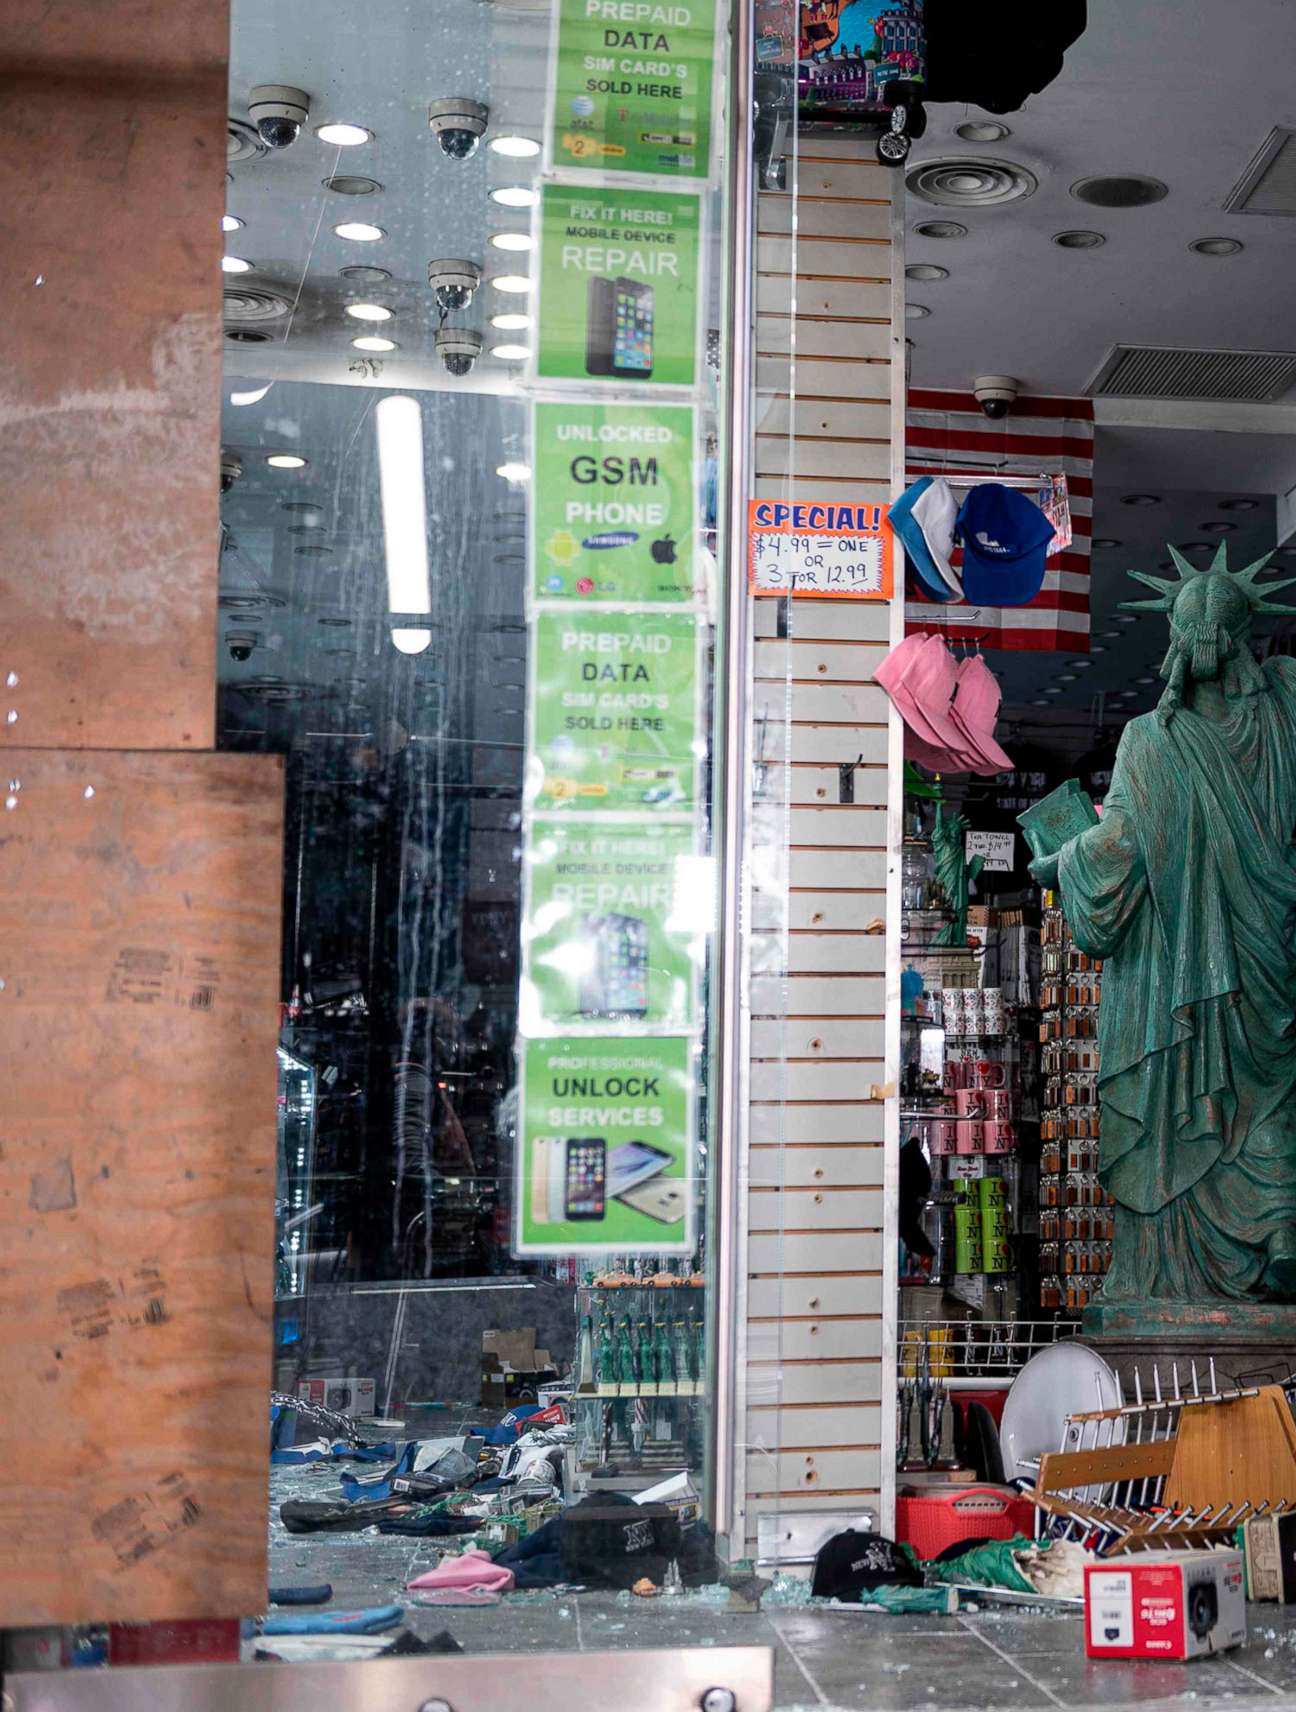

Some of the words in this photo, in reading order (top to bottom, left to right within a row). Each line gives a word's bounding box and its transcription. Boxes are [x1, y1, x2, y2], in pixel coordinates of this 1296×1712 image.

[585, 0, 692, 26] PREPAID
[604, 29, 670, 52] DATA
[584, 55, 615, 72] SIM
[620, 59, 688, 79] CARD'S
[586, 78, 632, 95] SOLD
[637, 83, 683, 99] HERE
[570, 206, 595, 222] FIX
[601, 208, 615, 223] IT
[620, 208, 673, 226] HERE!
[565, 225, 621, 242] MOBILE
[624, 229, 676, 245] DEVICE
[561, 245, 679, 277] REPAIR
[556, 424, 673, 443] UNLOCKED
[570, 455, 658, 486] GSM
[565, 502, 664, 525] PHONE
[754, 503, 881, 531] SPECIAL!
[757, 538, 810, 559] $4.99
[838, 540, 869, 553] ONE
[804, 555, 824, 568] OR
[767, 563, 783, 583] 3
[827, 563, 869, 586] 12.99
[562, 631, 672, 653] PREPAID
[582, 662, 650, 682] DATA
[562, 693, 595, 707] SIM
[565, 716, 612, 730] SOLD
[617, 717, 664, 731] HERE
[556, 863, 610, 875] MOBILE
[614, 863, 667, 875] DEVICE
[552, 882, 674, 909] REPAIR
[547, 1056, 664, 1070] PROFESSIONAL
[553, 1078, 660, 1098] UNLOCK
[547, 1106, 665, 1127] SERVICES
[865, 1541, 896, 1572] NY
